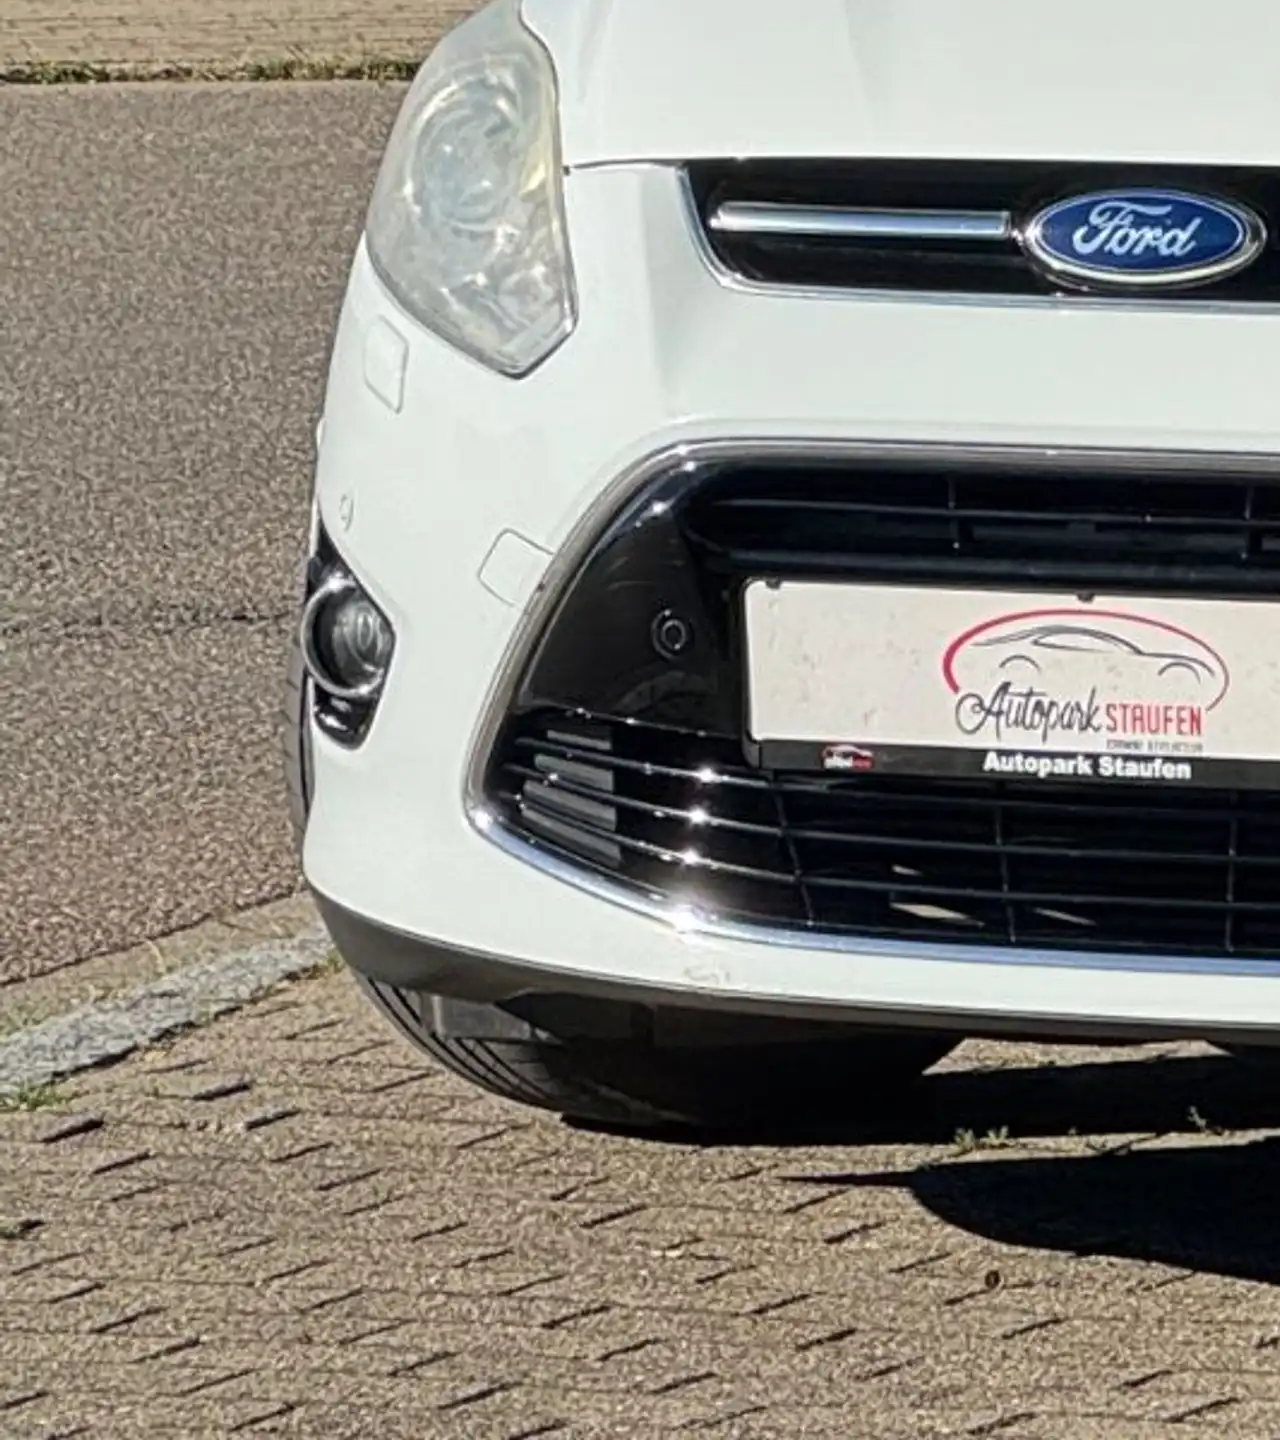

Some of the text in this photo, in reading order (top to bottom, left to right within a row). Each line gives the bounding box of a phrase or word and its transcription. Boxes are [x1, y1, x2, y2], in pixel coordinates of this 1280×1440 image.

[1072, 200, 1203, 257] Ford
[955, 680, 1203, 744] Autopark STAUFEN
[984, 751, 1191, 780] Autopark Staufen
